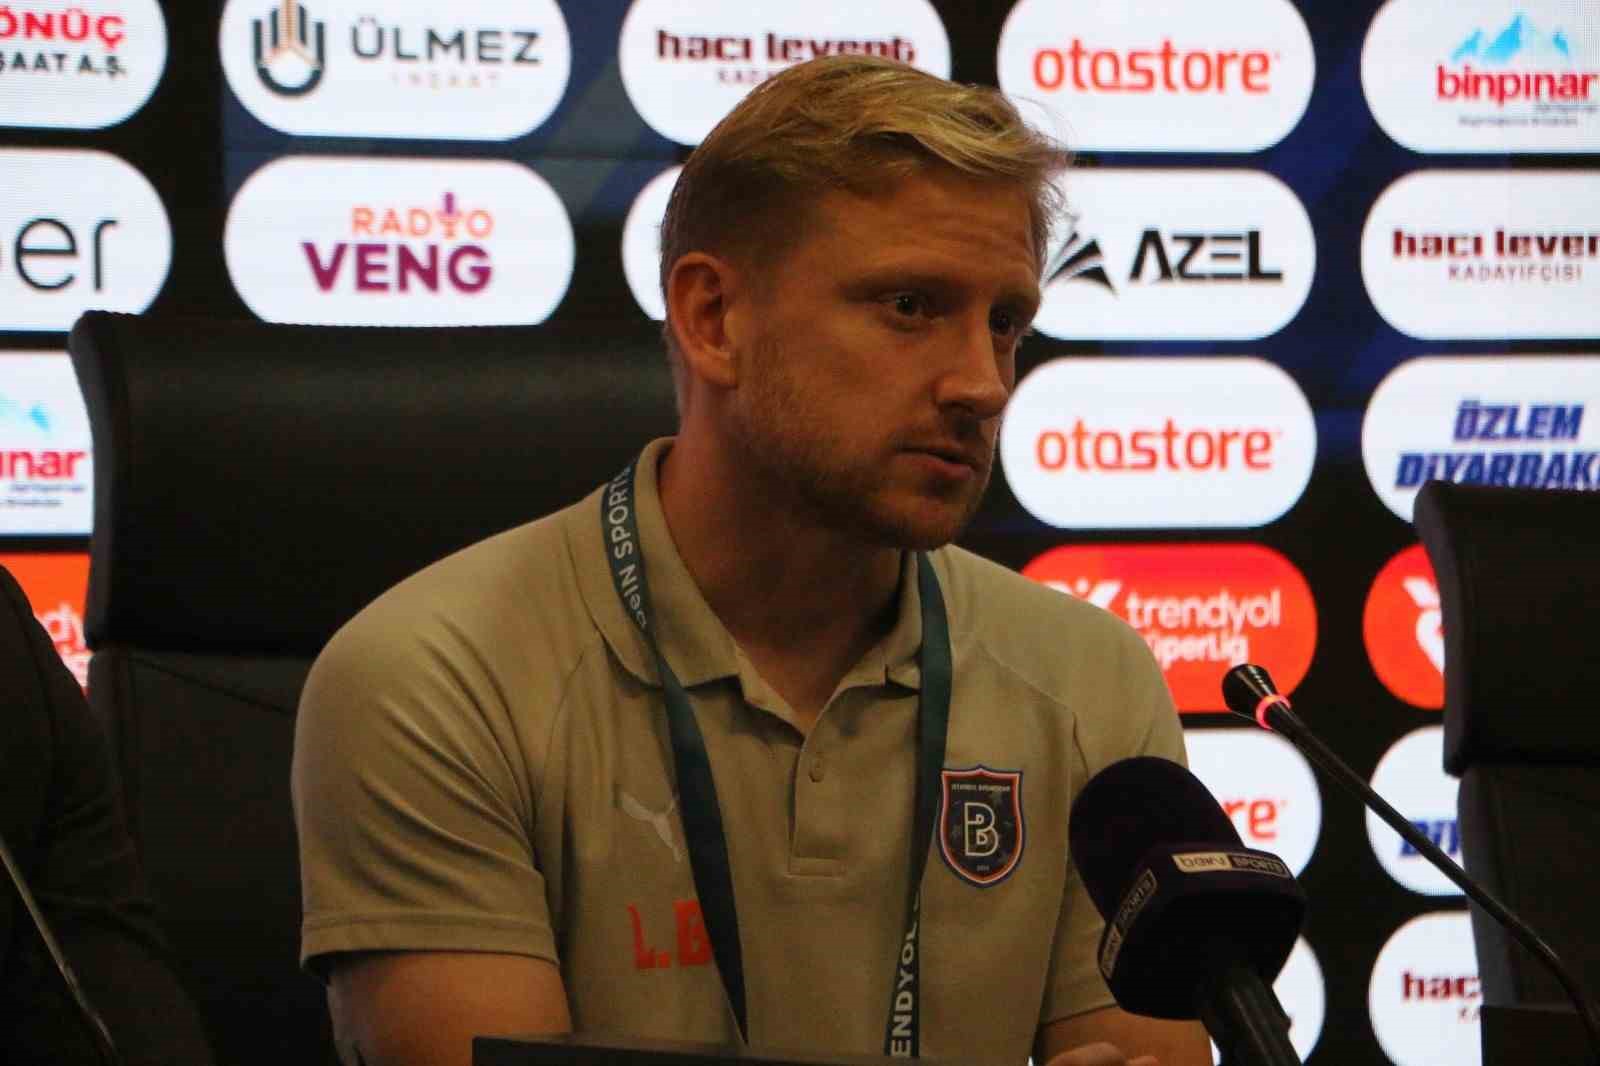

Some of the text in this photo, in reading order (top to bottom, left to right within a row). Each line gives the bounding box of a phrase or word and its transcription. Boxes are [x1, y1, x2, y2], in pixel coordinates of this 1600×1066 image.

[352, 16, 540, 64] ÜLMEZ
[302, 242, 492, 293] VENG
[1128, 229, 1283, 281] AZEL
[1454, 398, 1584, 440] ÖZLEM
[1126, 590, 1281, 633] trendyol
[1402, 972, 1482, 1000] hac
